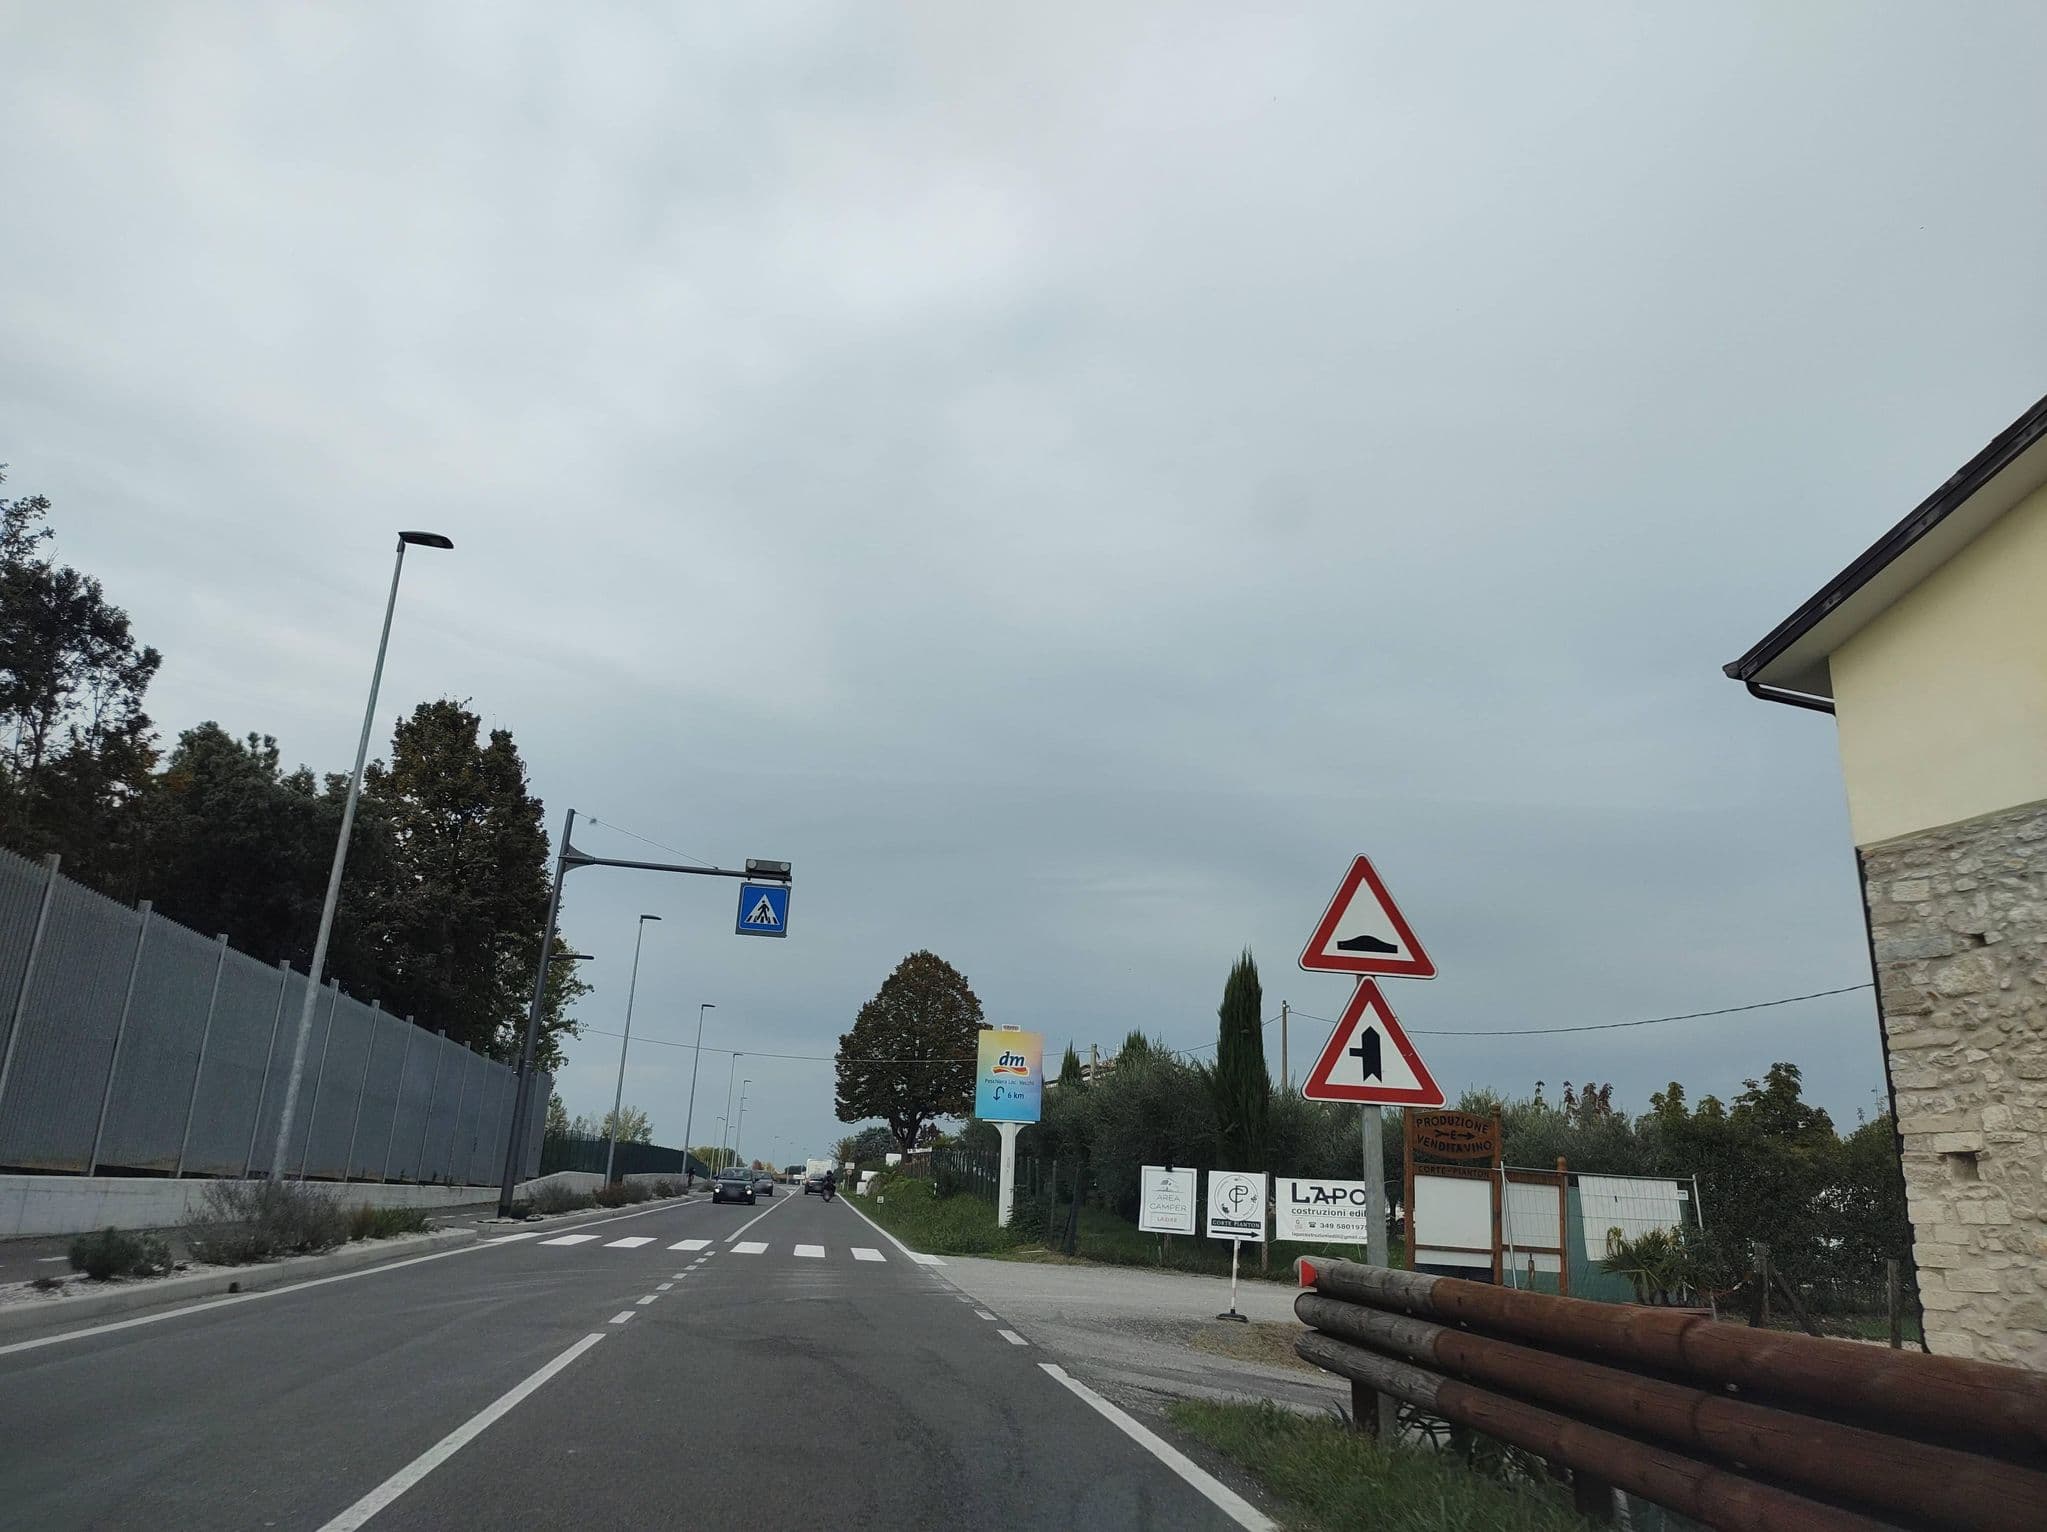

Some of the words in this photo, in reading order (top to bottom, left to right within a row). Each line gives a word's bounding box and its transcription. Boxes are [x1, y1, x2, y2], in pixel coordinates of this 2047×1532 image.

[999, 1051, 1025, 1067] dm
[1014, 1091, 1025, 1100] km
[1416, 1115, 1489, 1134] PRODUZIONE
[1417, 1134, 1462, 1153] VENDITA
[1464, 1141, 1492, 1153] VINO
[1156, 1194, 1181, 1203] AREA
[1291, 1182, 1367, 1206] LAPO
[1149, 1202, 1187, 1212] CAMPER
[1291, 1207, 1346, 1217] costruzioni
[1349, 1209, 1367, 1218] edil
[1212, 1219, 1233, 1228] CORTE
